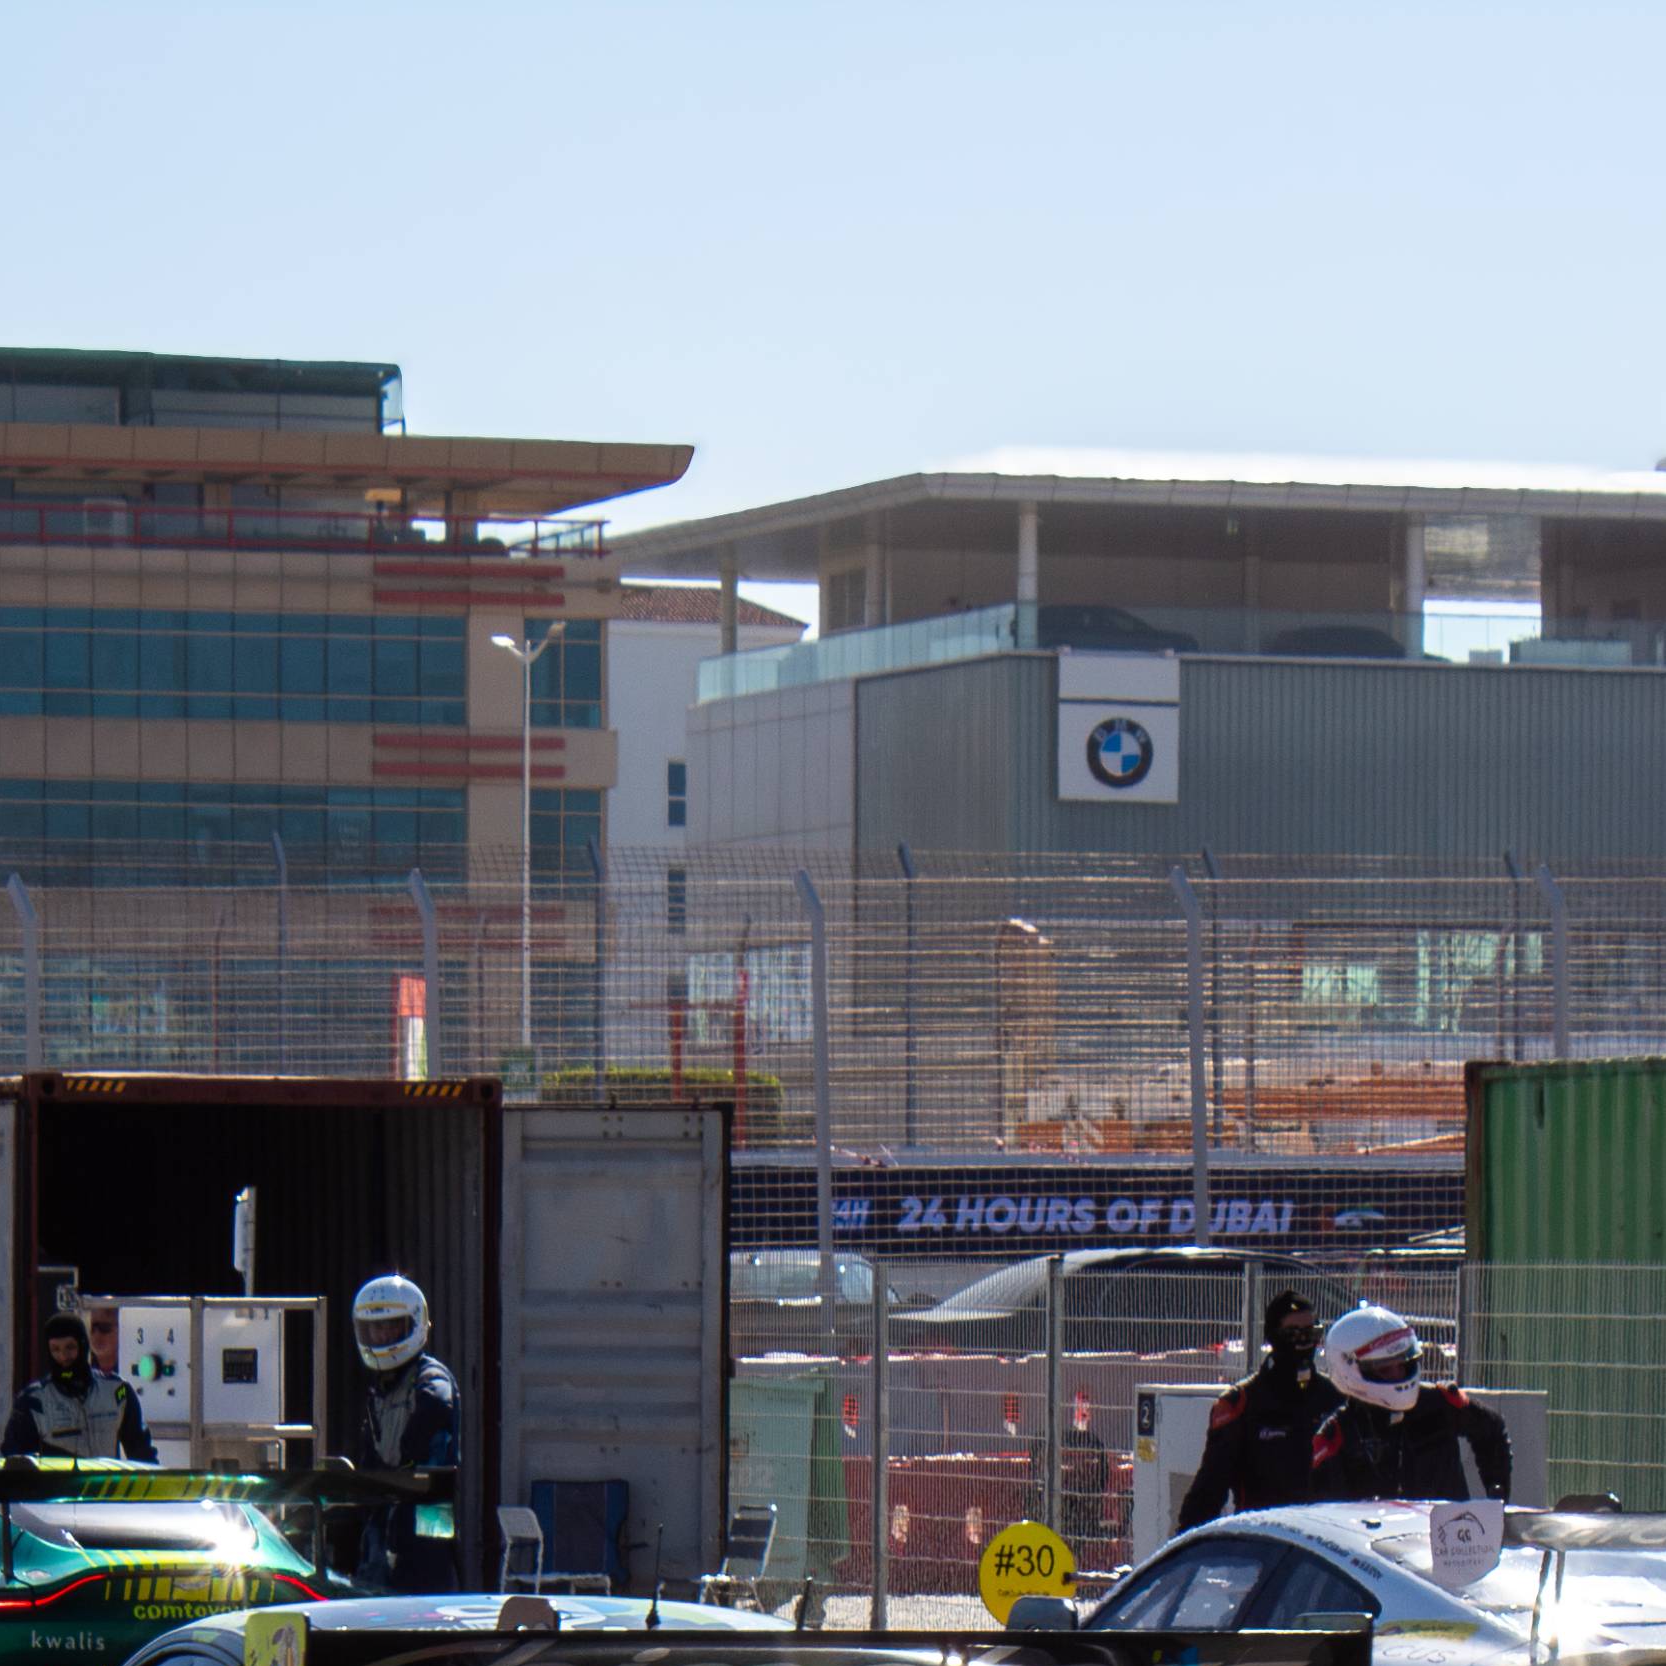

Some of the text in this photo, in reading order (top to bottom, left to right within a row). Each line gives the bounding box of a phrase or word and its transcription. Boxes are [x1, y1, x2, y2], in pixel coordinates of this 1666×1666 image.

[897, 1195, 1295, 1234] 24 HOURS OF DUBAI
[136, 1327, 175, 1345] 3 4
[1141, 1403, 1151, 1428] 2
[994, 1544, 1055, 1577] #30
[31, 1630, 106, 1651] kwalis
